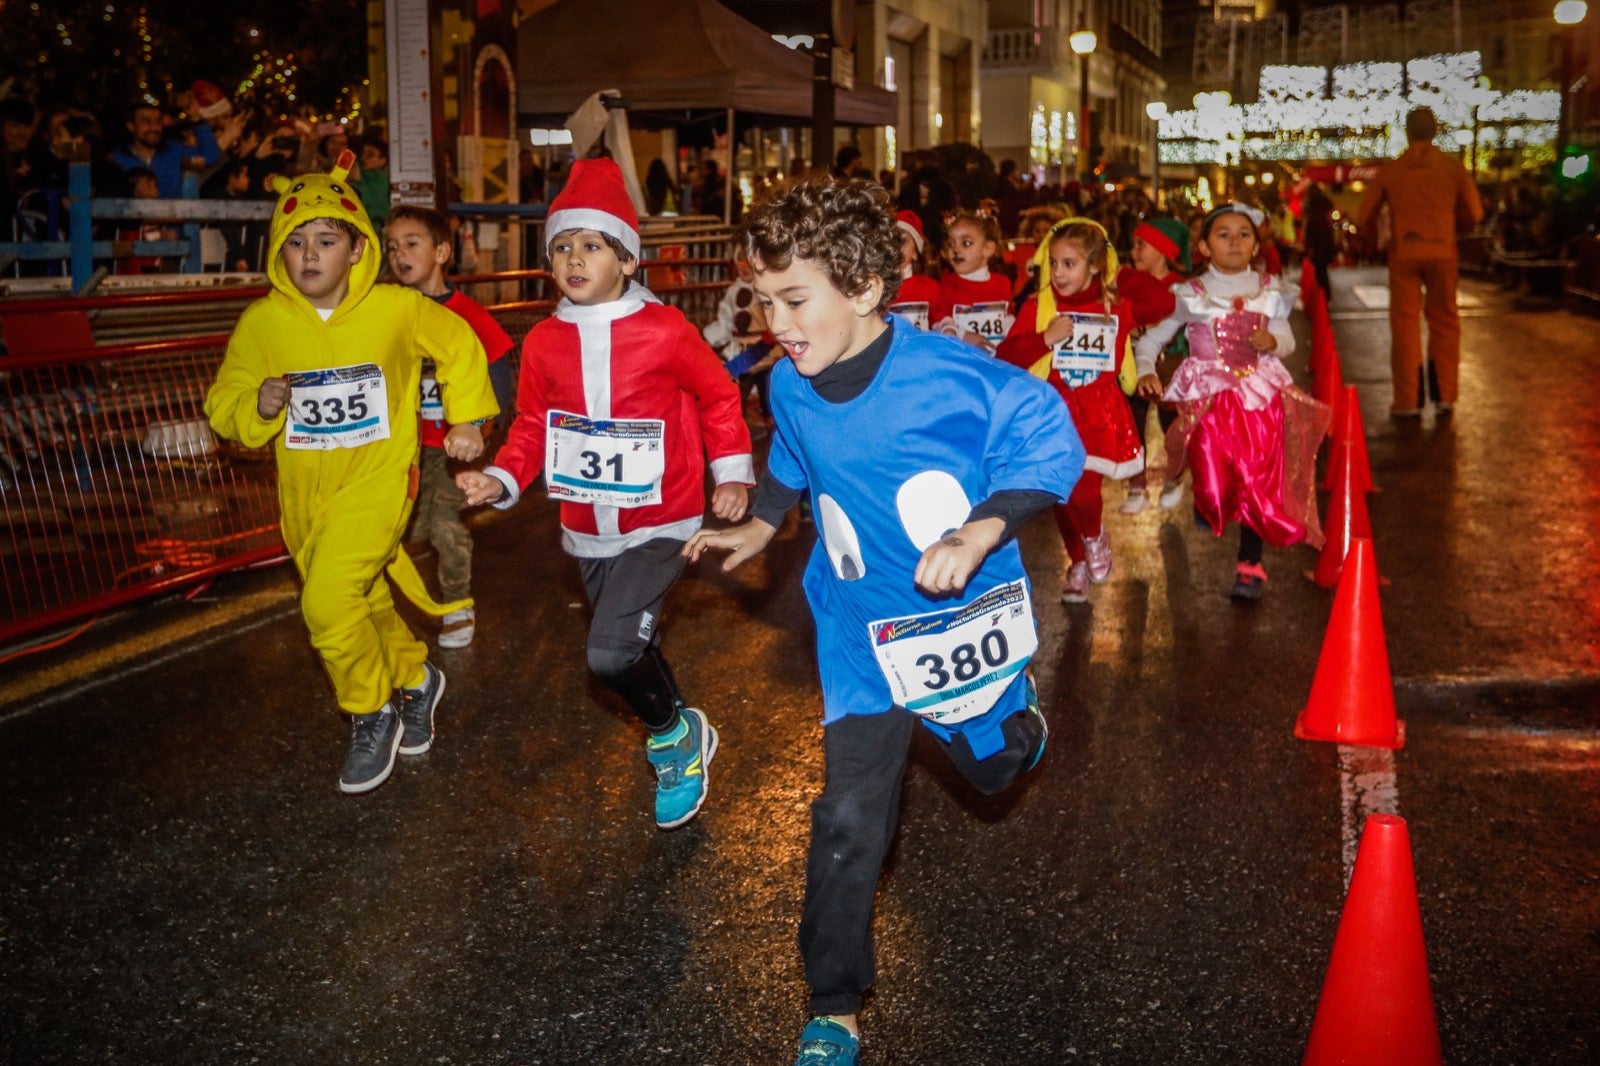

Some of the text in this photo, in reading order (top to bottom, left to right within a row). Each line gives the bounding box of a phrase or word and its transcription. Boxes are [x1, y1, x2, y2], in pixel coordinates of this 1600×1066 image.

[968, 319, 1003, 335] 348
[1060, 334, 1106, 352] 244
[301, 393, 368, 425] 335
[580, 450, 623, 482] 31
[915, 629, 1009, 690] 380
[954, 680, 981, 696] MARCOS
